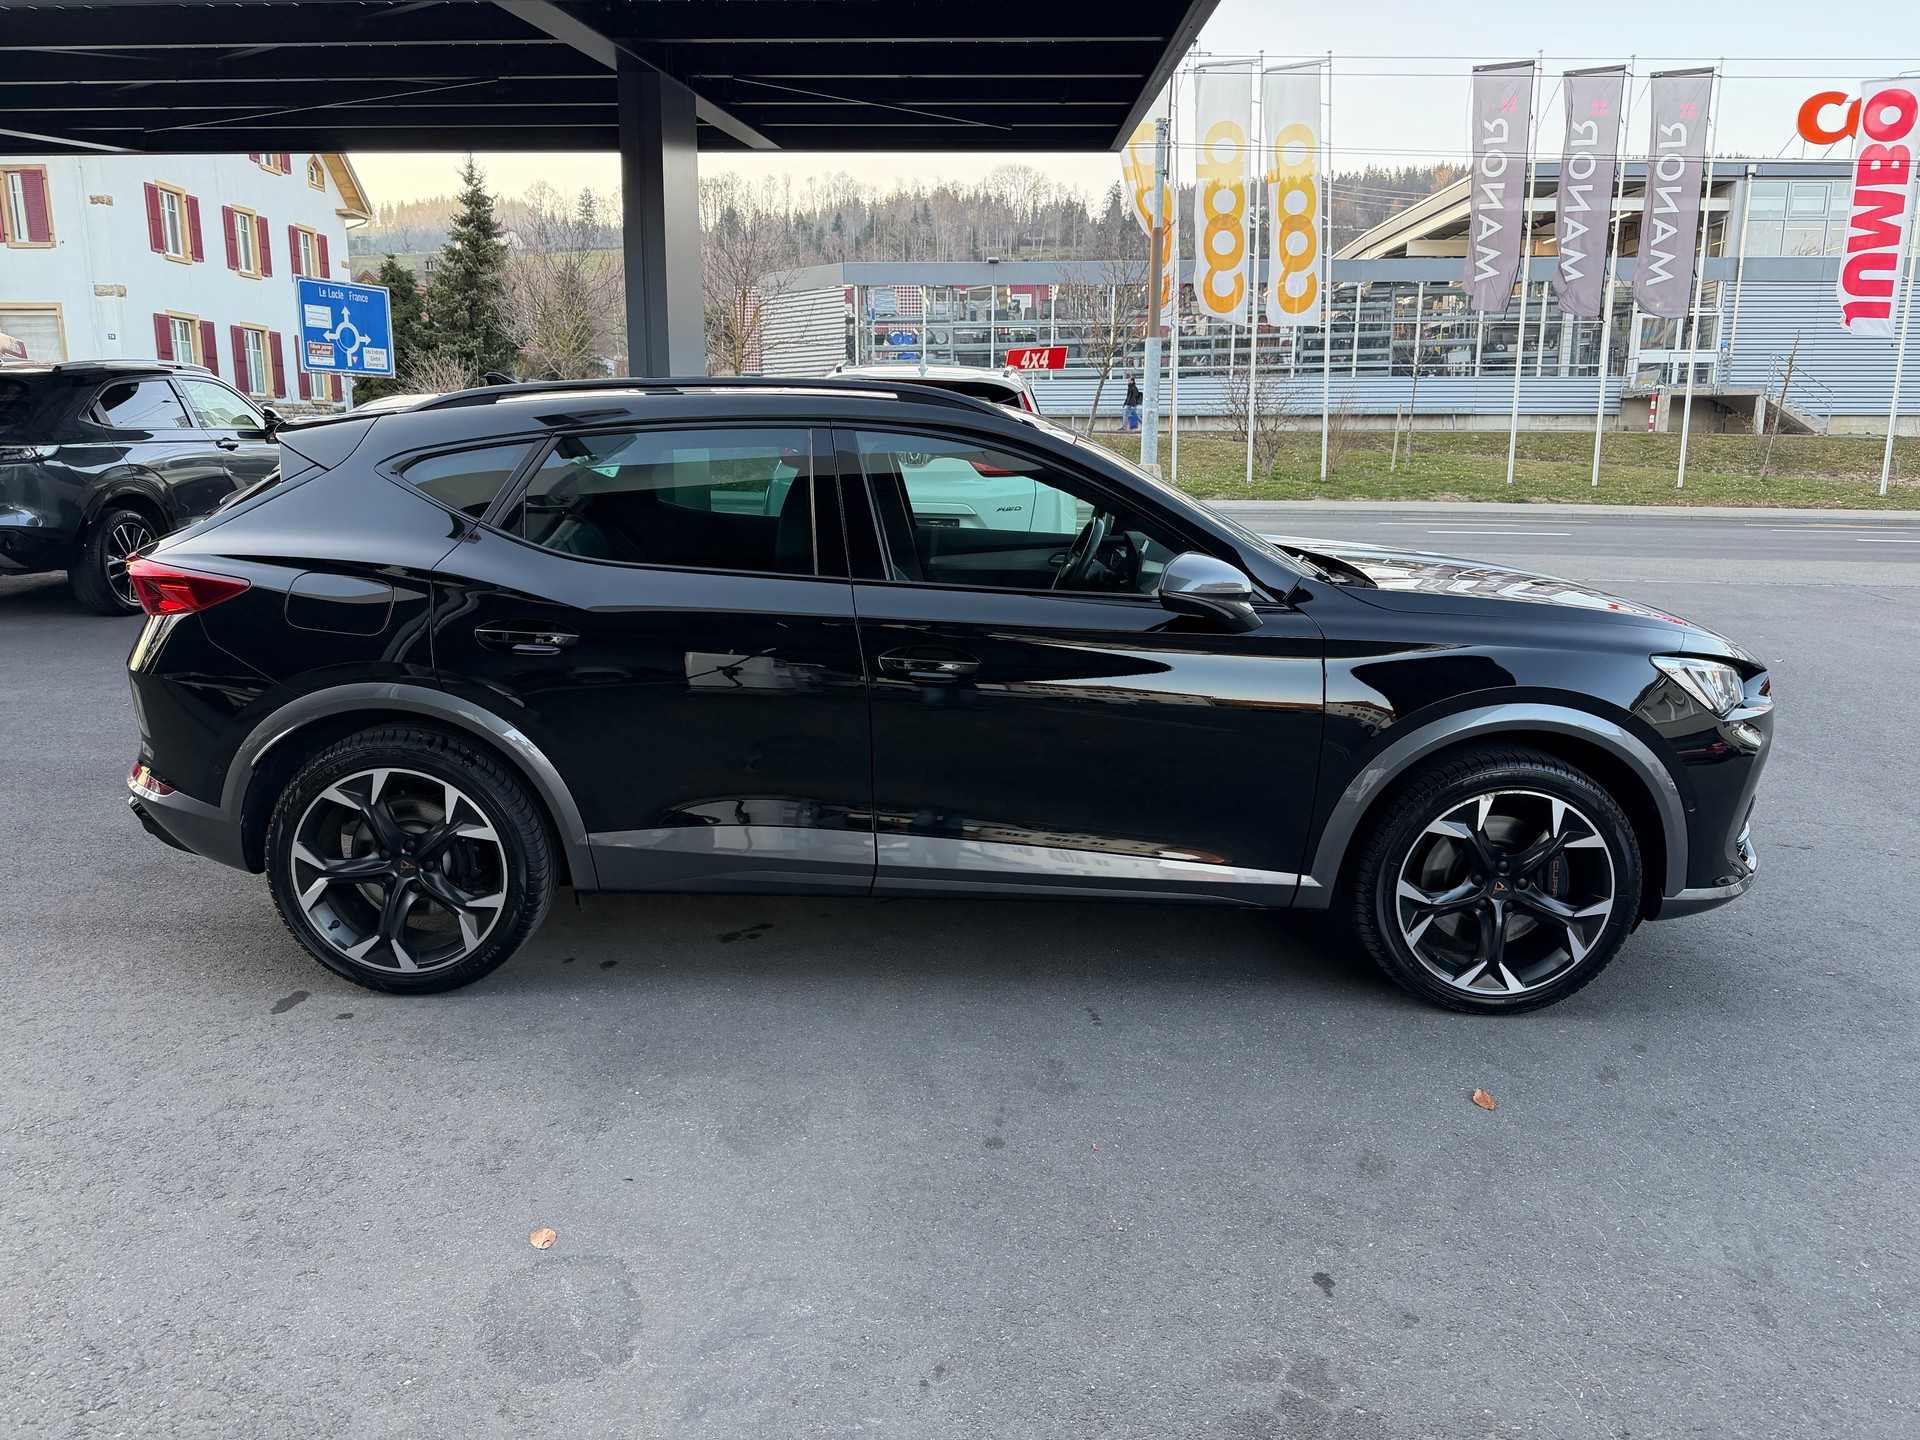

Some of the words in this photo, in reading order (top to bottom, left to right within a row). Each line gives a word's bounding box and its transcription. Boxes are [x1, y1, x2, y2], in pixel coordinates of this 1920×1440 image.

[318, 286, 327, 297] Le
[328, 287, 344, 300] Locle
[348, 291, 369, 303] France
[1020, 349, 1050, 369] 4x4
